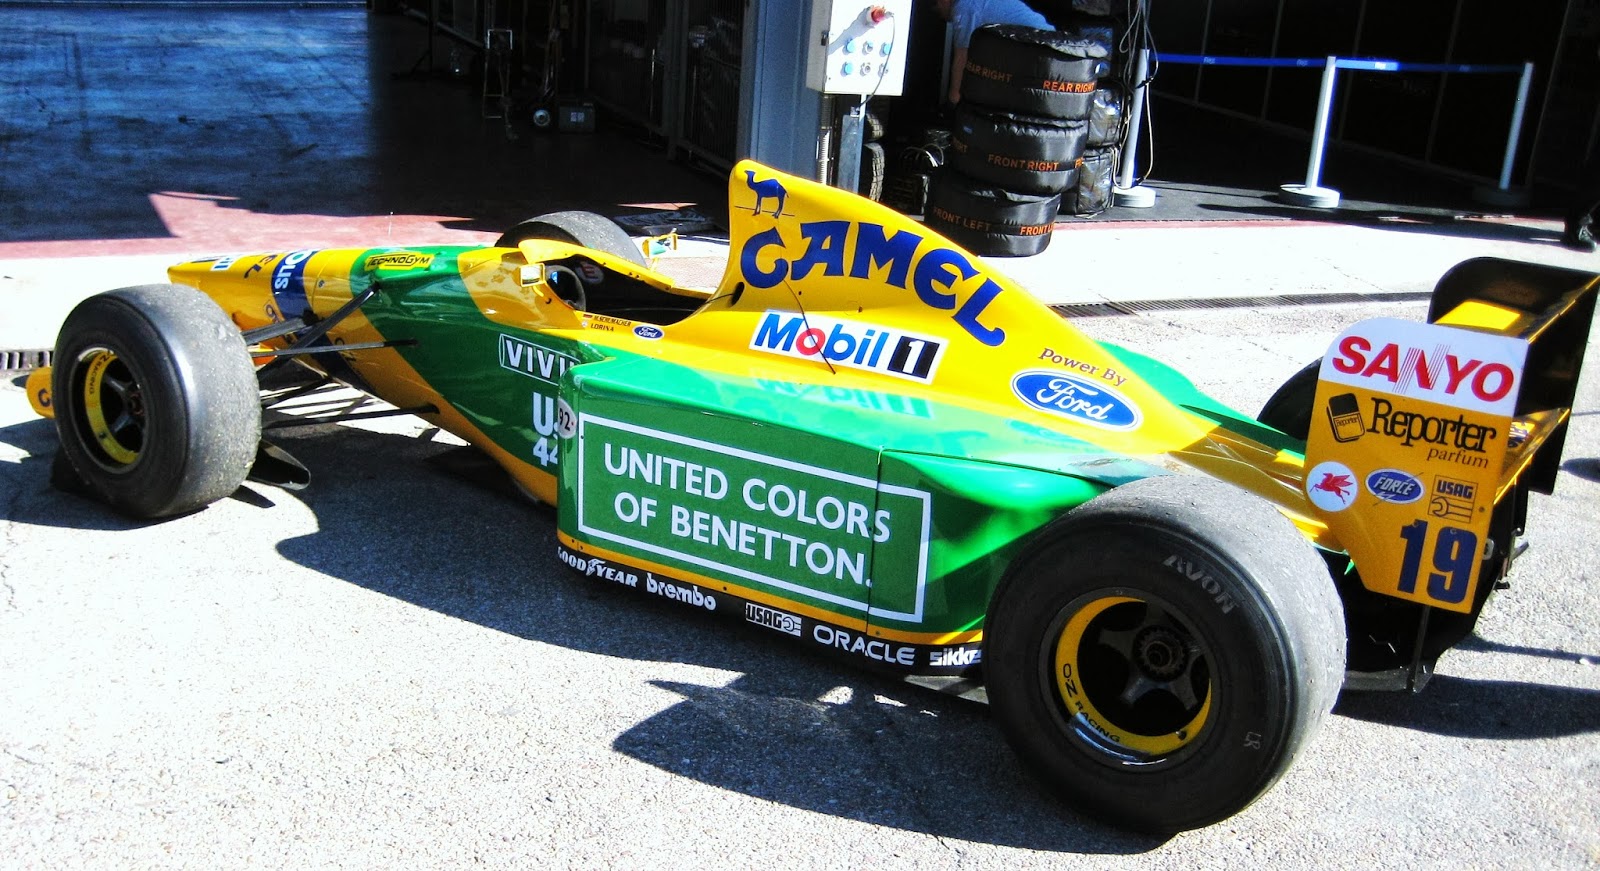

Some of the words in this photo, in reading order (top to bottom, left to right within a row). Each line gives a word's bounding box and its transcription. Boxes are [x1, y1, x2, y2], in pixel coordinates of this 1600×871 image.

[1043, 80, 1073, 92] REAR
[988, 154, 1025, 168] FRONT
[1027, 161, 1059, 171] RIGHT
[933, 206, 961, 225] FRONT
[963, 218, 993, 232] LEFT
[1020, 226, 1047, 236] FRONT
[740, 220, 1005, 346] CAMEL
[637, 326, 658, 338] Ford
[754, 313, 889, 368] Mobil
[1038, 348, 1099, 375] Power
[1101, 368, 1127, 387] By
[1332, 336, 1514, 402] SANYO
[1036, 378, 1114, 420] Ford
[1366, 397, 1497, 454] Reporter
[1426, 447, 1489, 469] parfum
[604, 442, 728, 500] UNITED
[742, 478, 892, 543] COLORS
[1373, 476, 1415, 496] FORCE
[1436, 479, 1474, 499] USAG
[614, 491, 657, 527] OF
[671, 506, 873, 588] BENETTON.
[1397, 519, 1478, 604] 19
[647, 572, 717, 611] brembo
[1162, 554, 1240, 614] AVON
[746, 604, 783, 629] USAG
[813, 624, 916, 666] ORACLE
[1075, 700, 1121, 743] RACING
